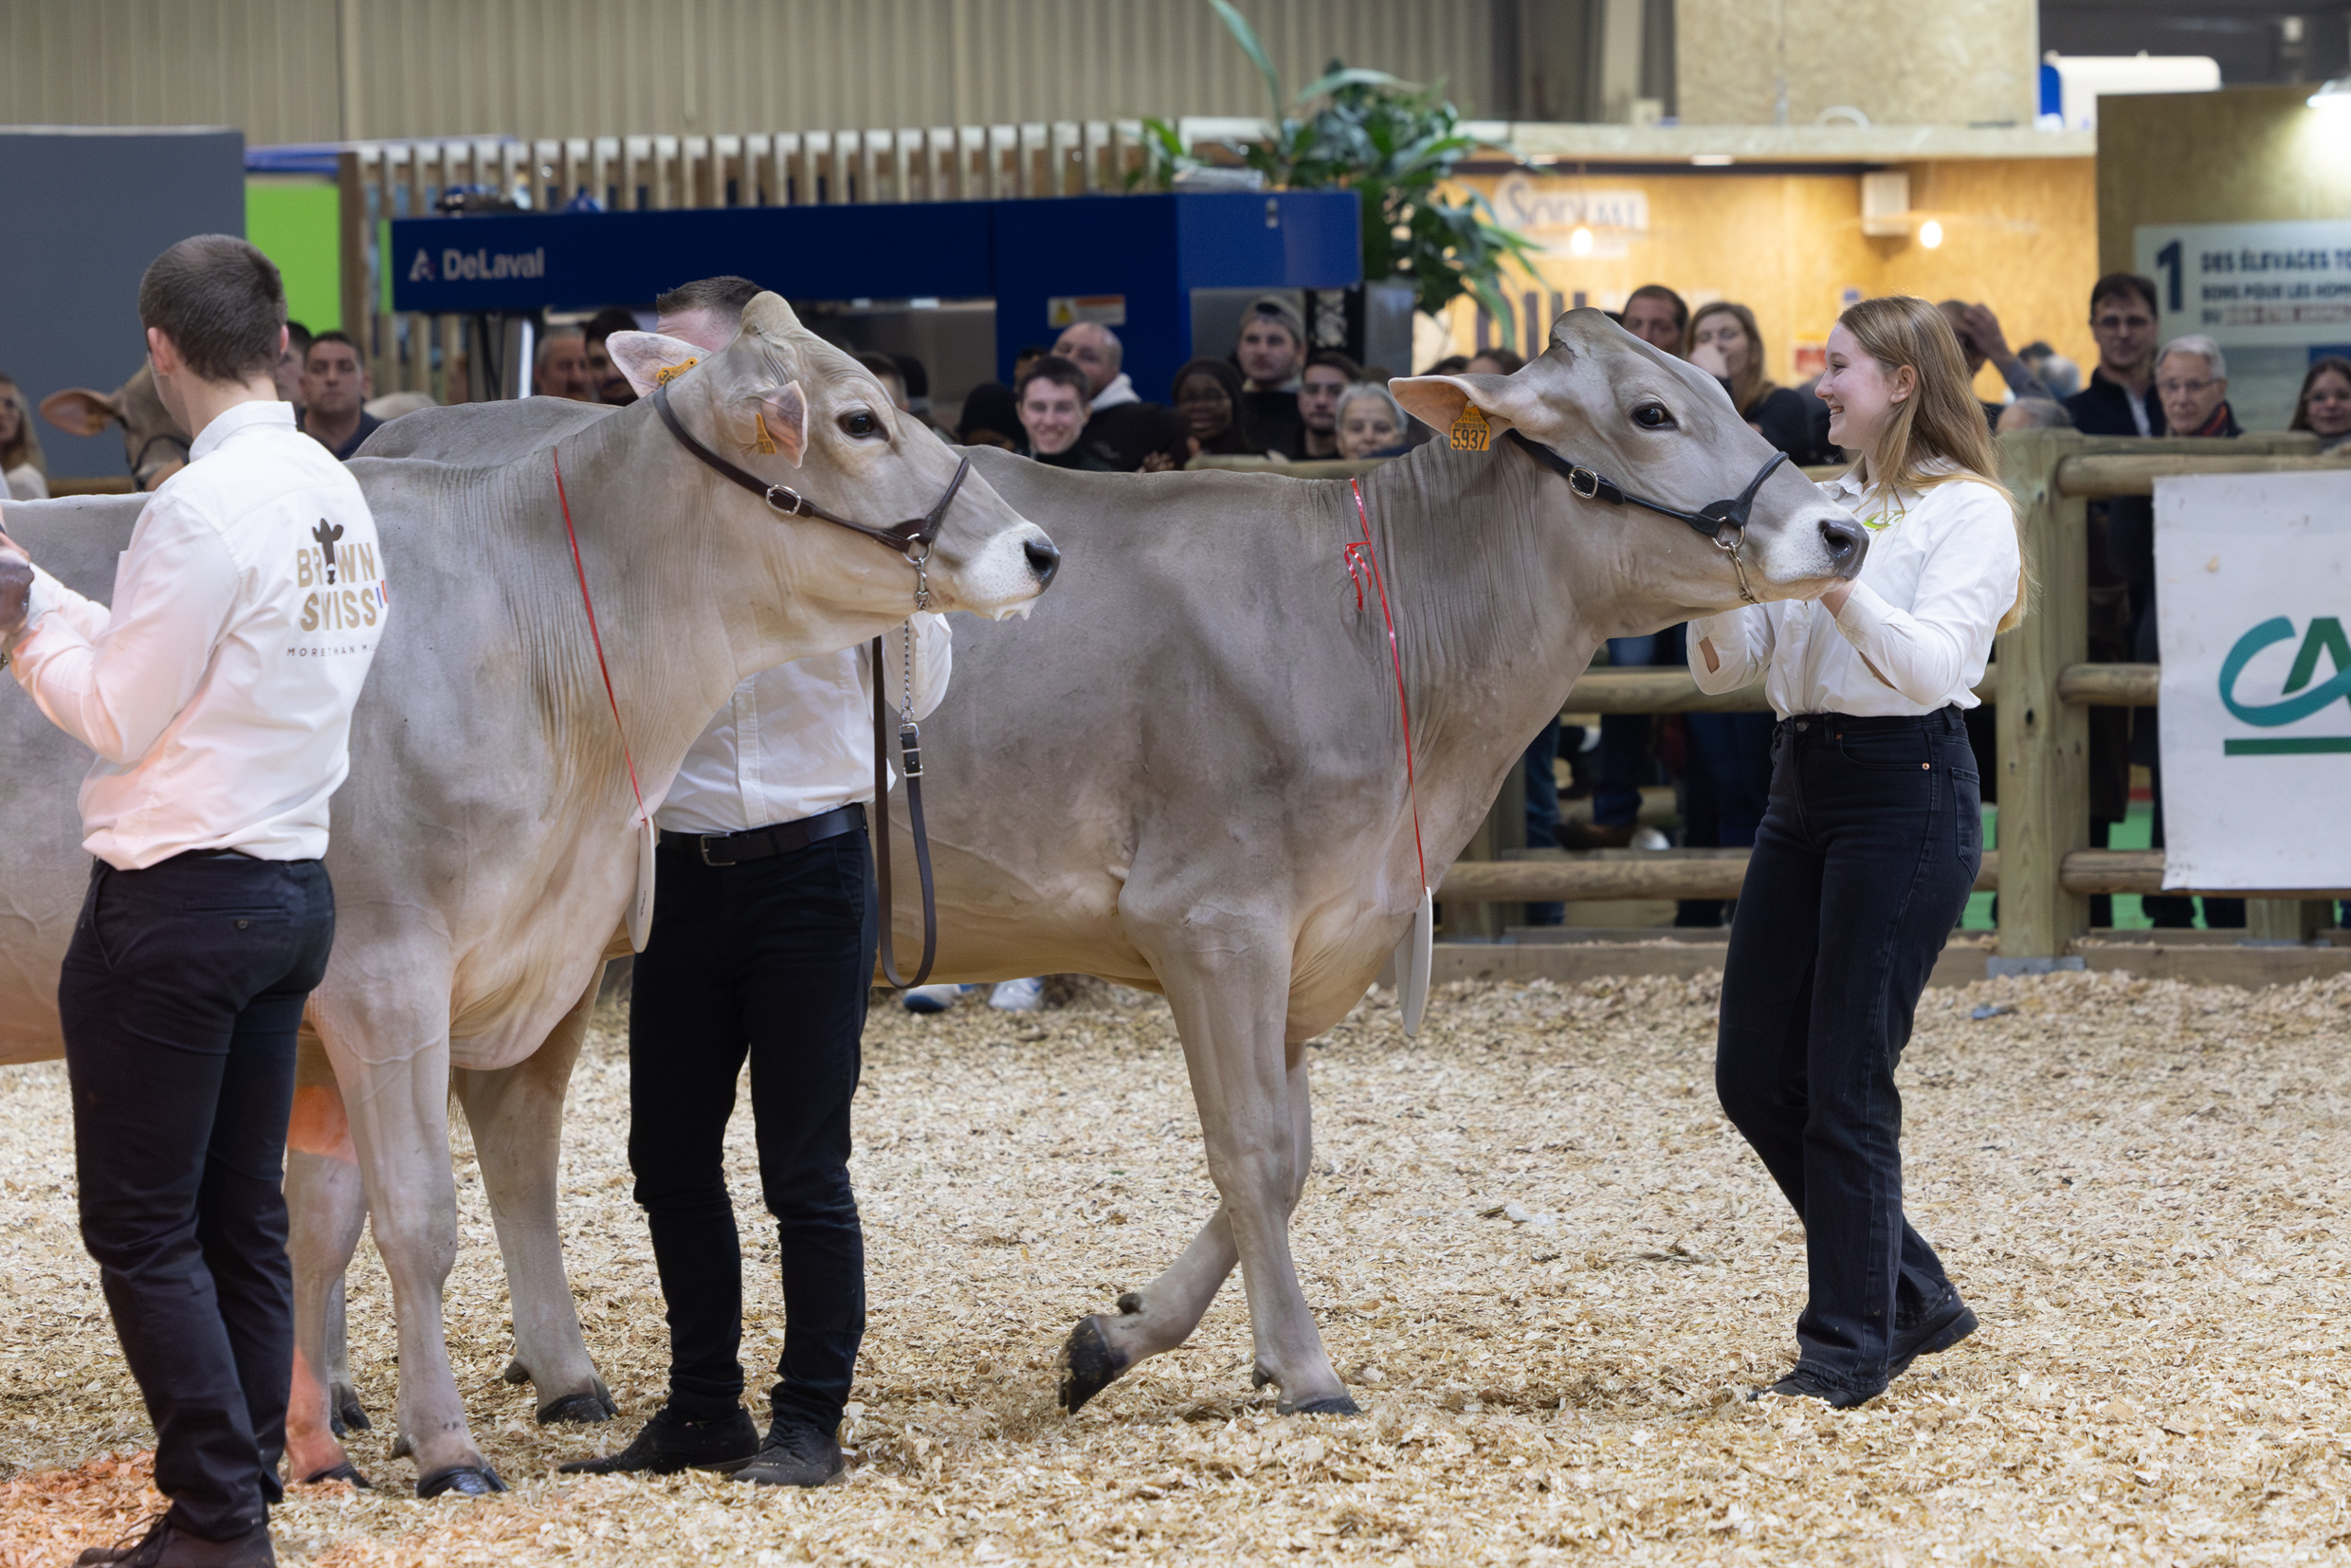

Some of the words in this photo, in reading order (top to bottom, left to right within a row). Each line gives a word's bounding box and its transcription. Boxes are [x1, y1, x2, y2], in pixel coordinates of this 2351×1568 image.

[442, 246, 545, 282] DeLaval
[2156, 239, 2184, 313] 1
[1452, 428, 1487, 450] 5937
[297, 542, 376, 588] BRWN
[286, 647, 325, 657] MORE
